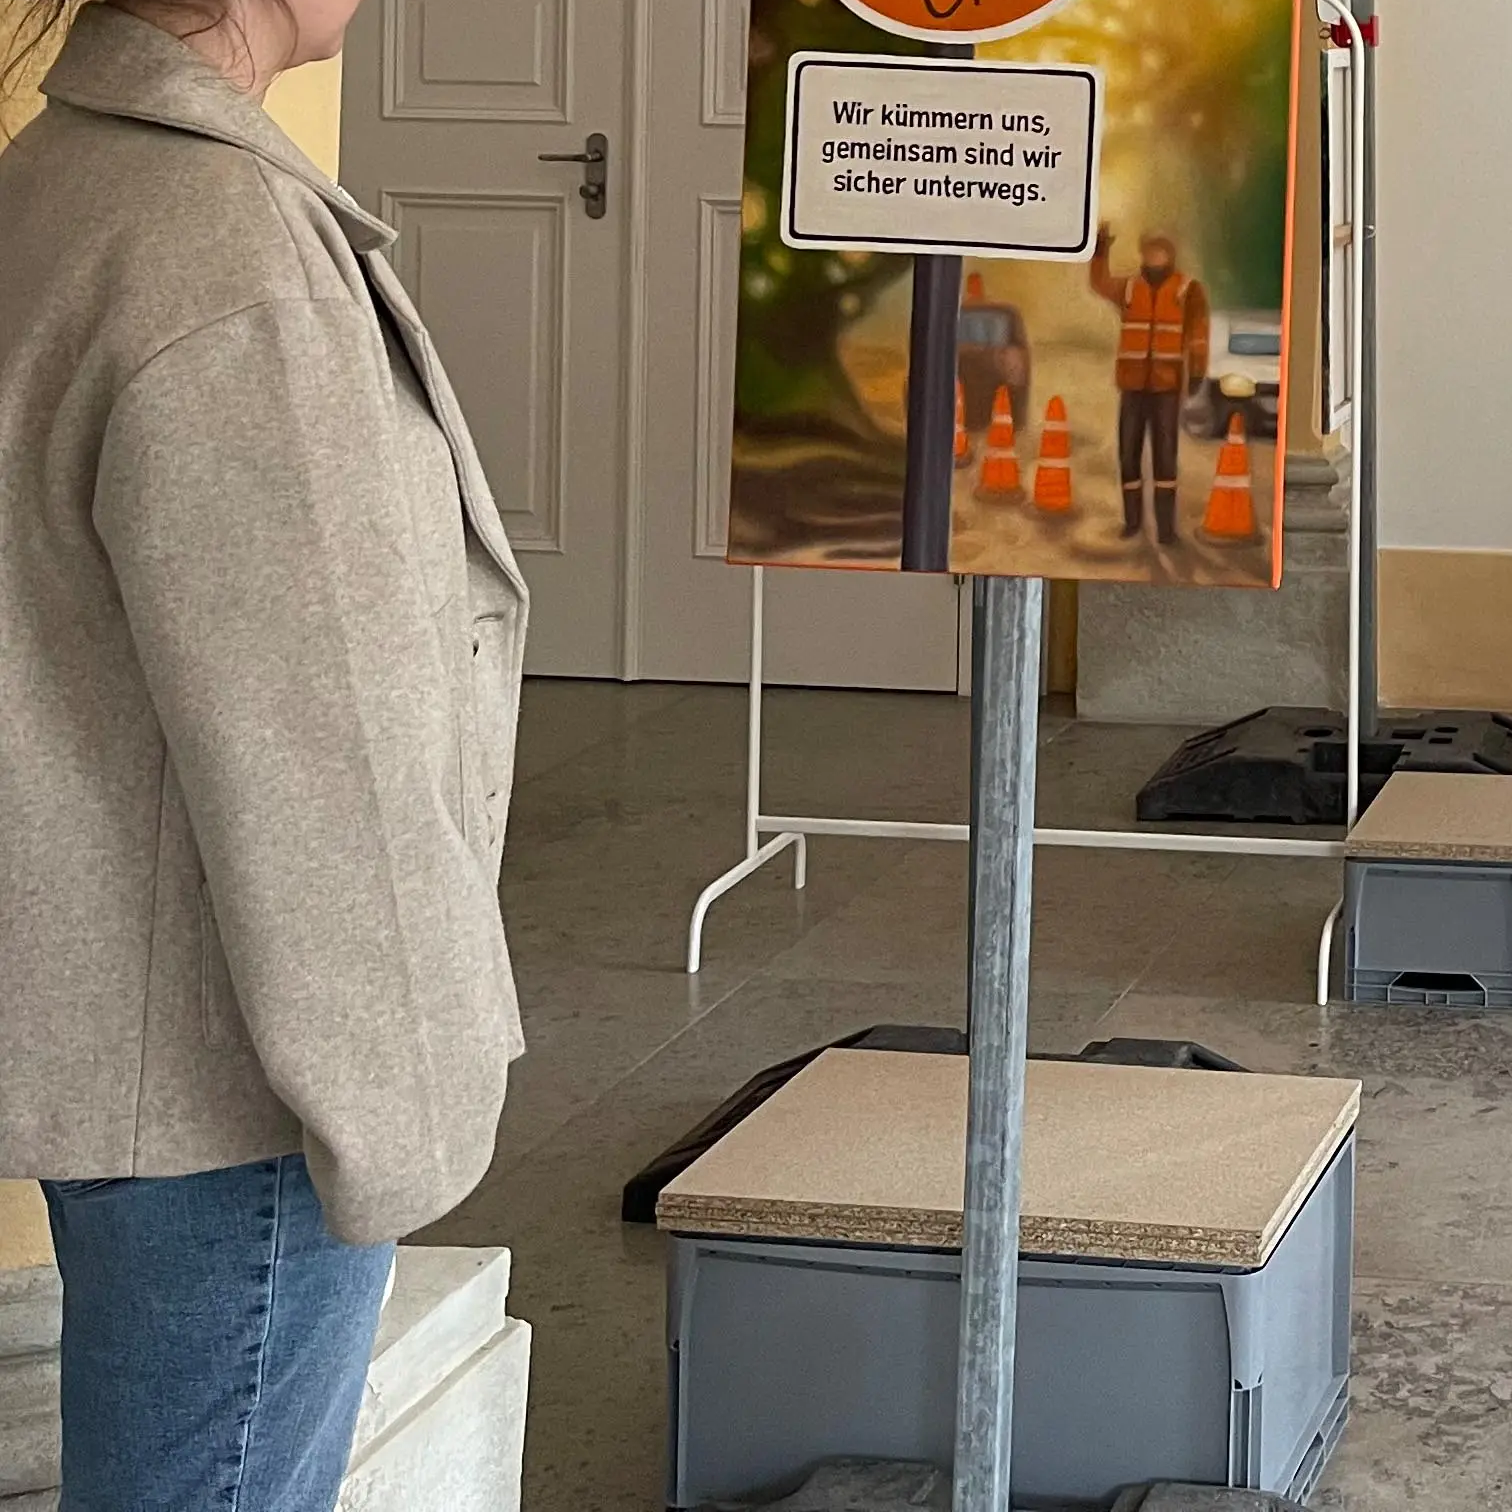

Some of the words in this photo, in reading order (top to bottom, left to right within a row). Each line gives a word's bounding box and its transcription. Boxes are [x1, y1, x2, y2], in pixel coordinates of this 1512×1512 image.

[832, 100, 874, 125] Wir
[881, 103, 993, 130] kümmern
[1001, 113, 1051, 136] uns,
[821, 138, 957, 164] gemeinsam
[964, 142, 1014, 167] sind
[1022, 145, 1062, 169] wir
[833, 169, 907, 195] sicher
[914, 175, 1046, 207] unterwegs.
